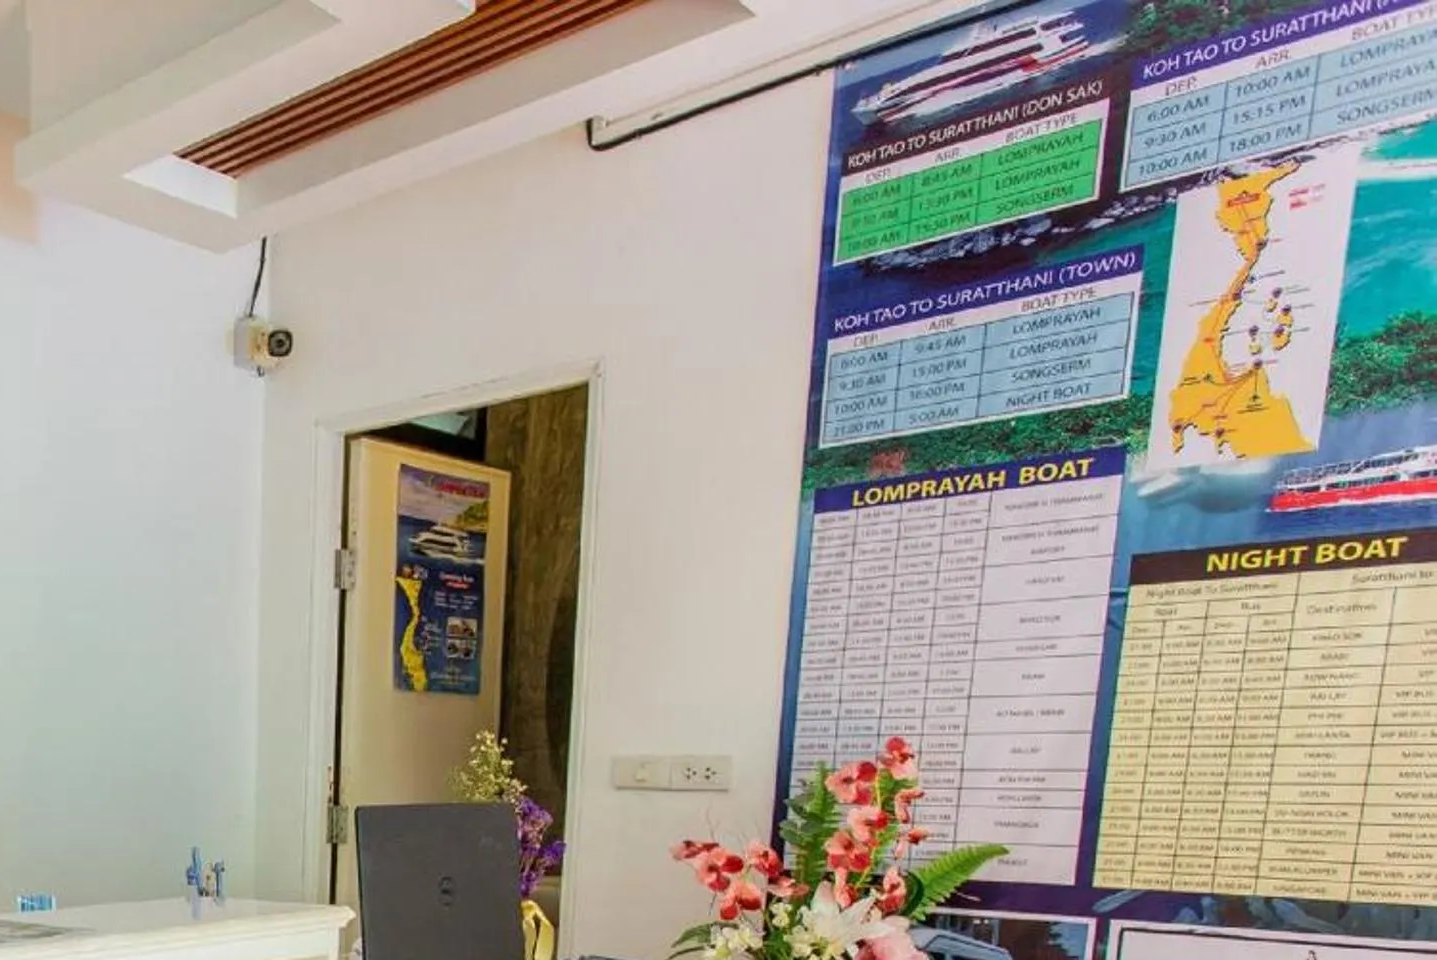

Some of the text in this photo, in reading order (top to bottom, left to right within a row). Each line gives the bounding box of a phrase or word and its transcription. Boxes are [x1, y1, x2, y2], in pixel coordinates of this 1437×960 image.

[1142, 55, 1180, 79] KOH
[1182, 44, 1218, 66] TAO
[1221, 36, 1247, 56] TO
[1250, 0, 1372, 47] SURATTHANI
[1234, 65, 1311, 98] 10:00 AM
[1182, 95, 1211, 114] AM
[1278, 93, 1307, 114] PM
[847, 79, 1104, 169] KOH TAO TO SURATTHANI (DON SAK)
[1179, 122, 1207, 142] AM
[1275, 122, 1304, 143] PM
[998, 132, 1084, 164] LOMPRAYAH
[995, 158, 1082, 190] LOMPRAYAH
[1138, 148, 1208, 177] 10:00 AM
[834, 253, 1136, 333] KOH TAO TO SURATTHANI (TOWN)
[1021, 287, 1097, 313] BOAT TYPE
[1012, 306, 1102, 335] LOMPRAYAH
[945, 335, 966, 348] AM
[1009, 331, 1098, 360] LOMPRAYAH
[869, 351, 888, 363] AM
[945, 358, 967, 371] PM
[866, 373, 886, 385] AM
[1012, 358, 1091, 383] SONGSERM
[944, 382, 965, 395] PM
[1006, 382, 1091, 408] NIGHT BOAT
[867, 396, 888, 409] AM
[938, 406, 959, 419] AM
[865, 418, 885, 431] PM
[851, 470, 1006, 508] LOMPRAYAH
[1018, 457, 1094, 486] BOAT
[1206, 536, 1409, 573] NIGHT BOAT
